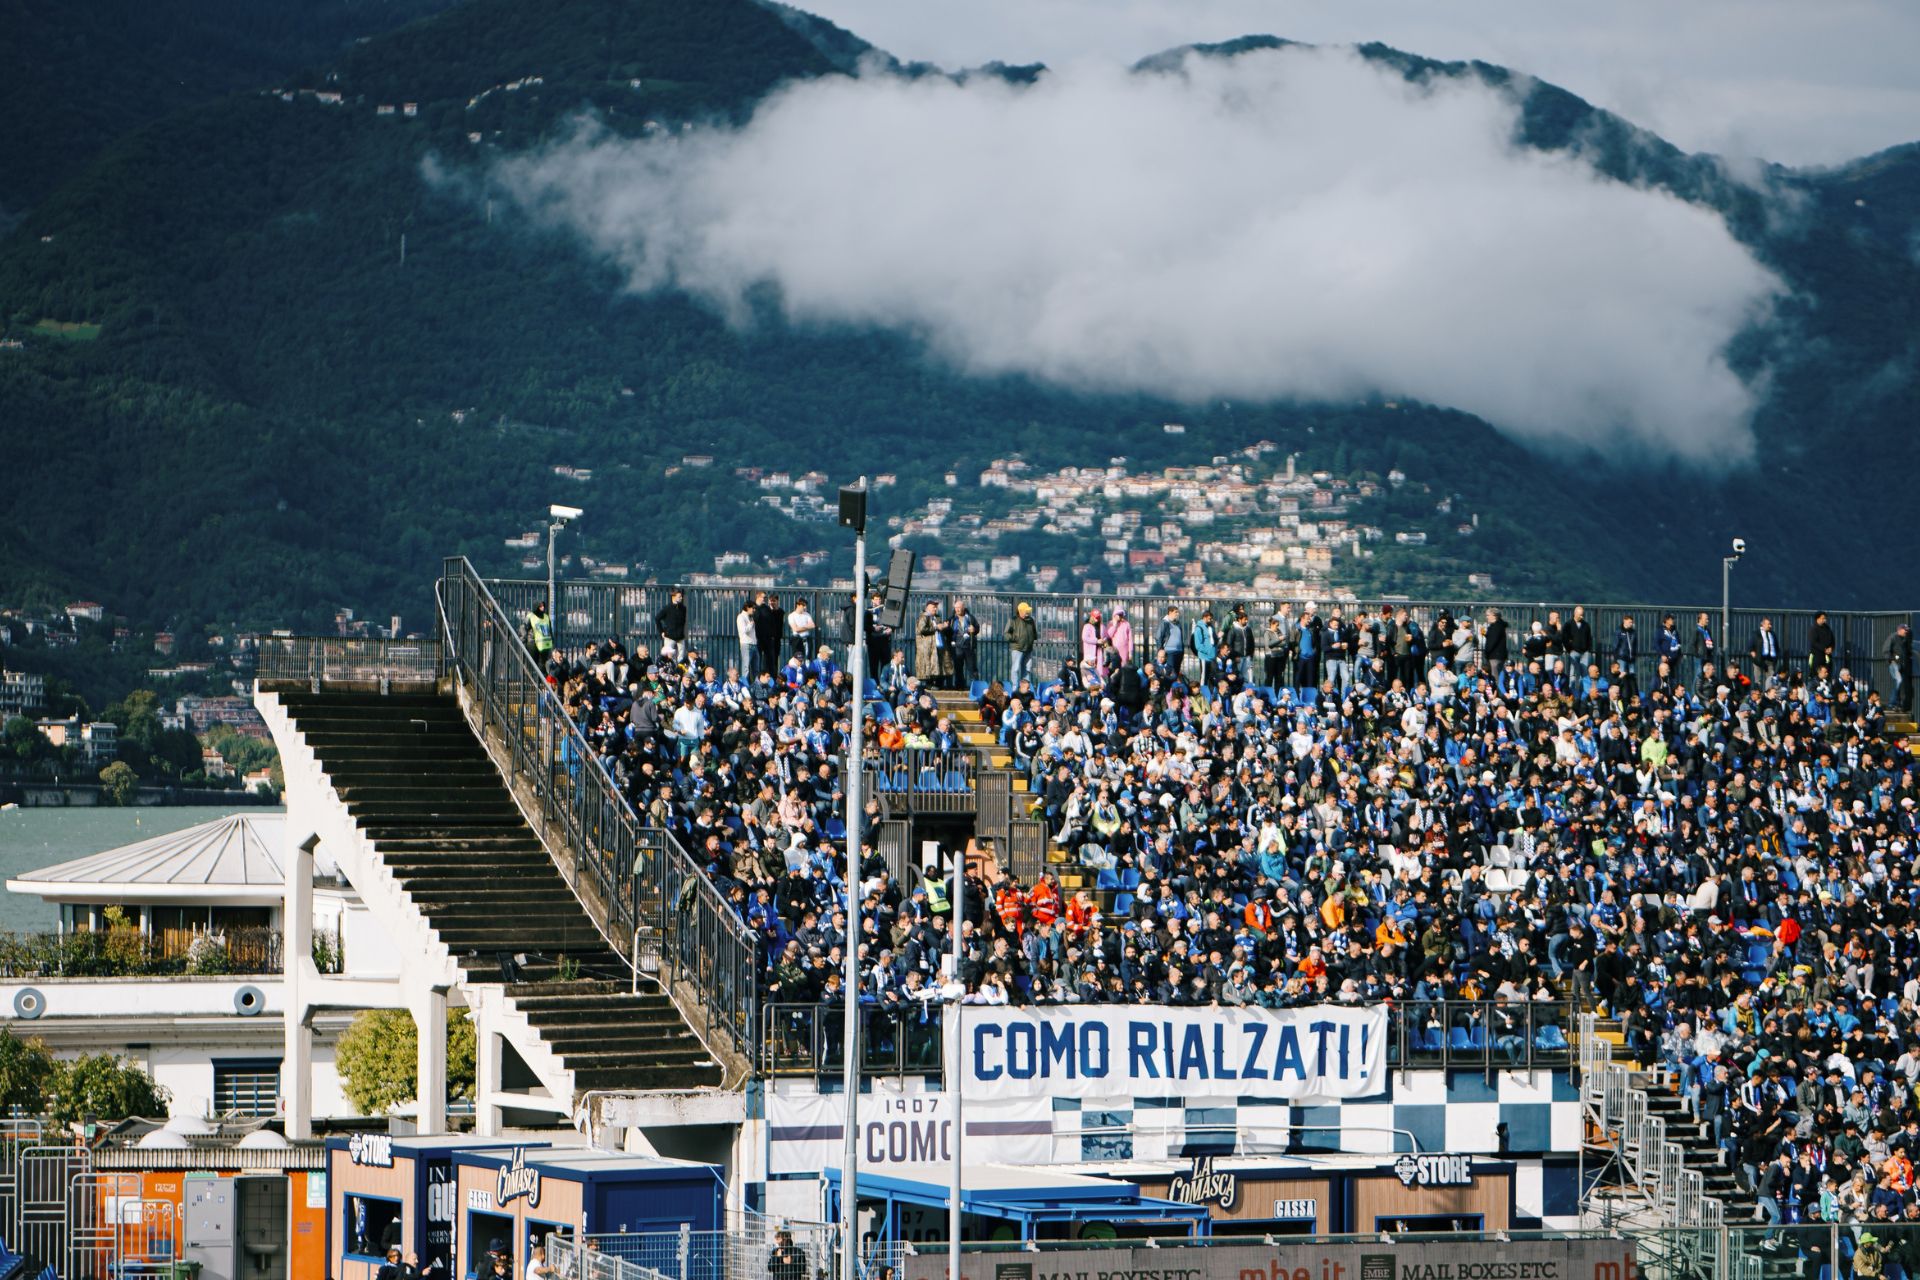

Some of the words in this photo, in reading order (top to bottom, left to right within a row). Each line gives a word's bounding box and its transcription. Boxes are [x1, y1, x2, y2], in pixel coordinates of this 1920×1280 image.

[973, 1021, 1110, 1081] COMO
[1128, 1021, 1369, 1081] RIALZATI!
[886, 1099, 938, 1114] 1907
[361, 1134, 392, 1167] STORE
[512, 1147, 525, 1170] LA
[429, 1167, 446, 1182] IN
[1192, 1156, 1213, 1180] LA
[1417, 1156, 1472, 1184] STORE
[498, 1165, 539, 1205] COMASCA
[1169, 1174, 1235, 1207] COMASCA
[879, 1211, 924, 1225] 107
[1276, 1201, 1314, 1217] CASSA
[1240, 1259, 1346, 1280] mbeit
[1366, 1269, 1390, 1278] MBE
[1402, 1264, 1453, 1280] MAIL
[1459, 1263, 1517, 1280] BOXES
[1521, 1262, 1559, 1278] ETC.
